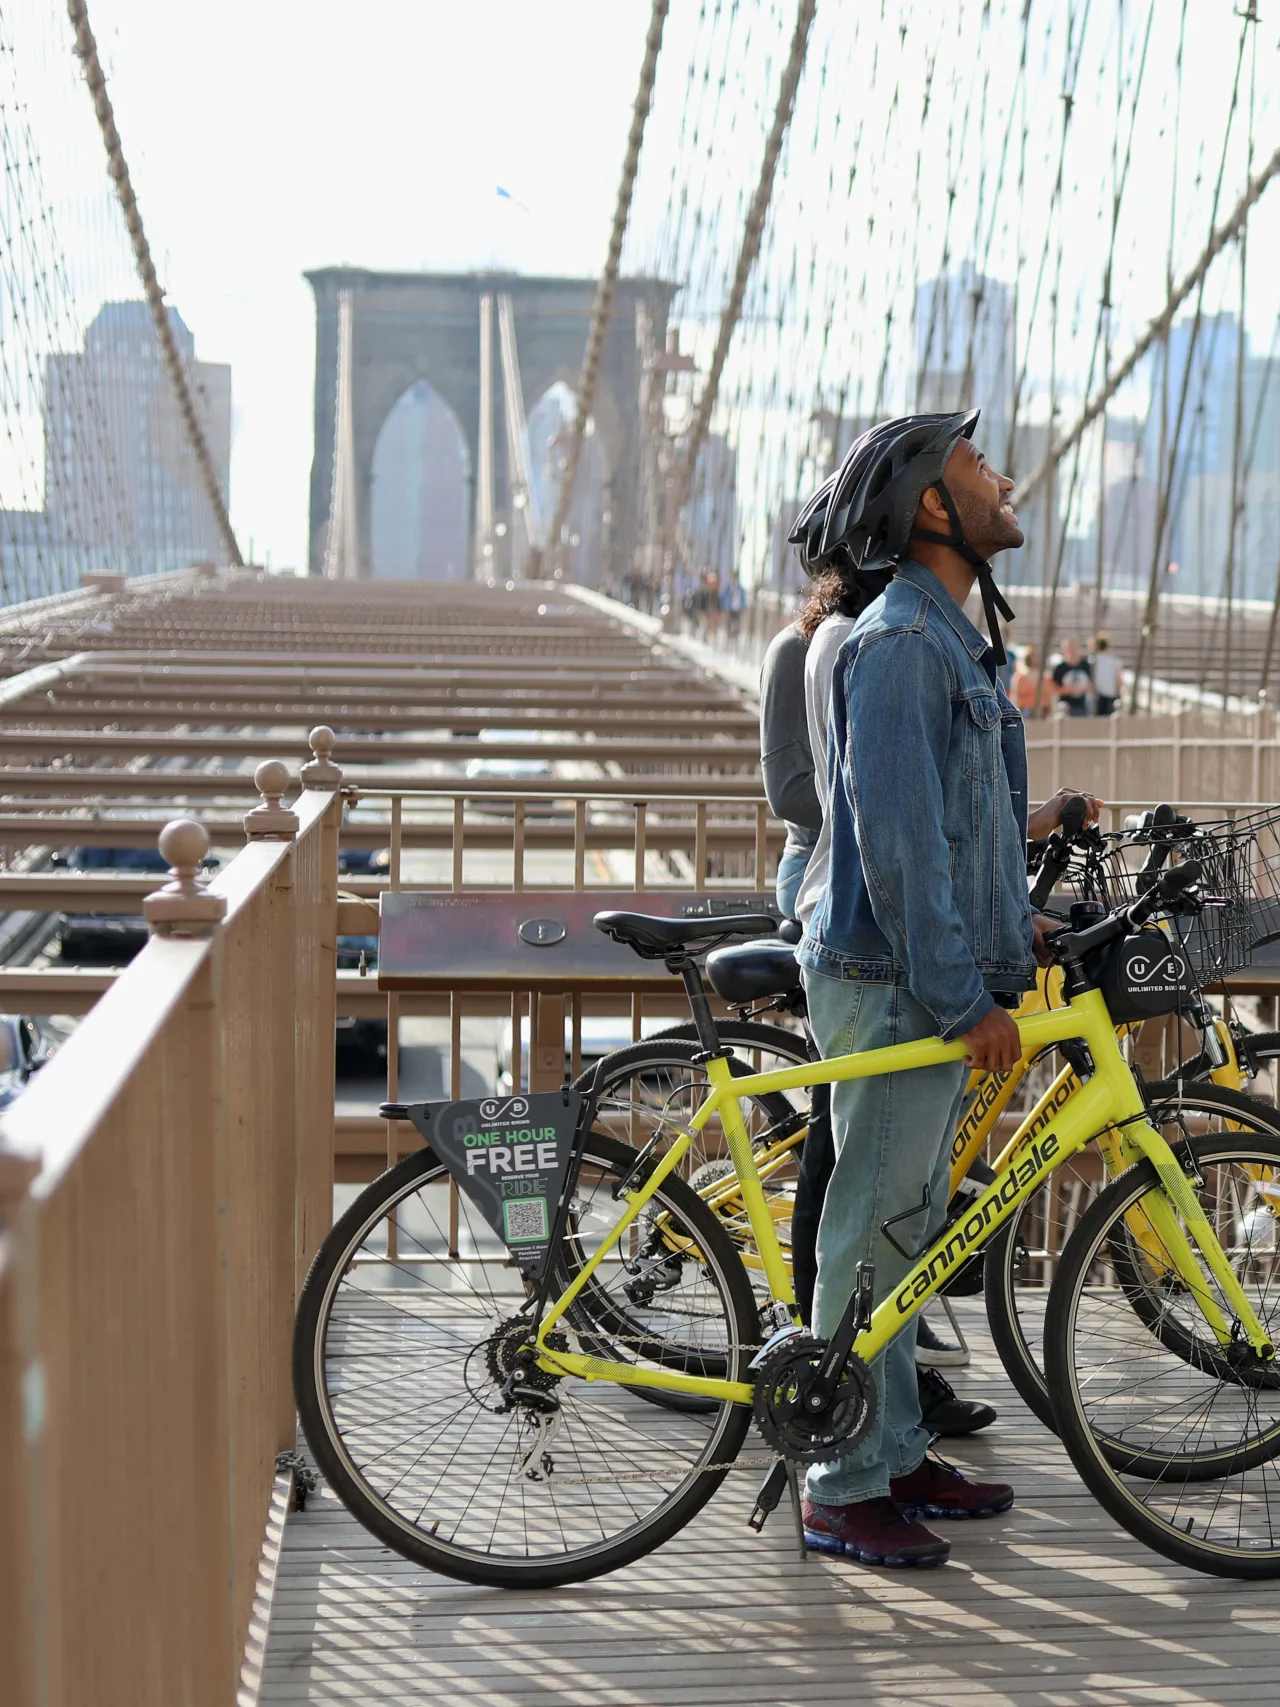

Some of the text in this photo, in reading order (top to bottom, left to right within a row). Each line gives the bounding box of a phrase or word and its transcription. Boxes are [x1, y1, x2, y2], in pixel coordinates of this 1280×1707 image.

[463, 1127, 556, 1147] ONE HOUR
[466, 1142, 558, 1176] FREE
[496, 1178, 548, 1197] RIDE
[896, 1133, 1060, 1314] cannondale
